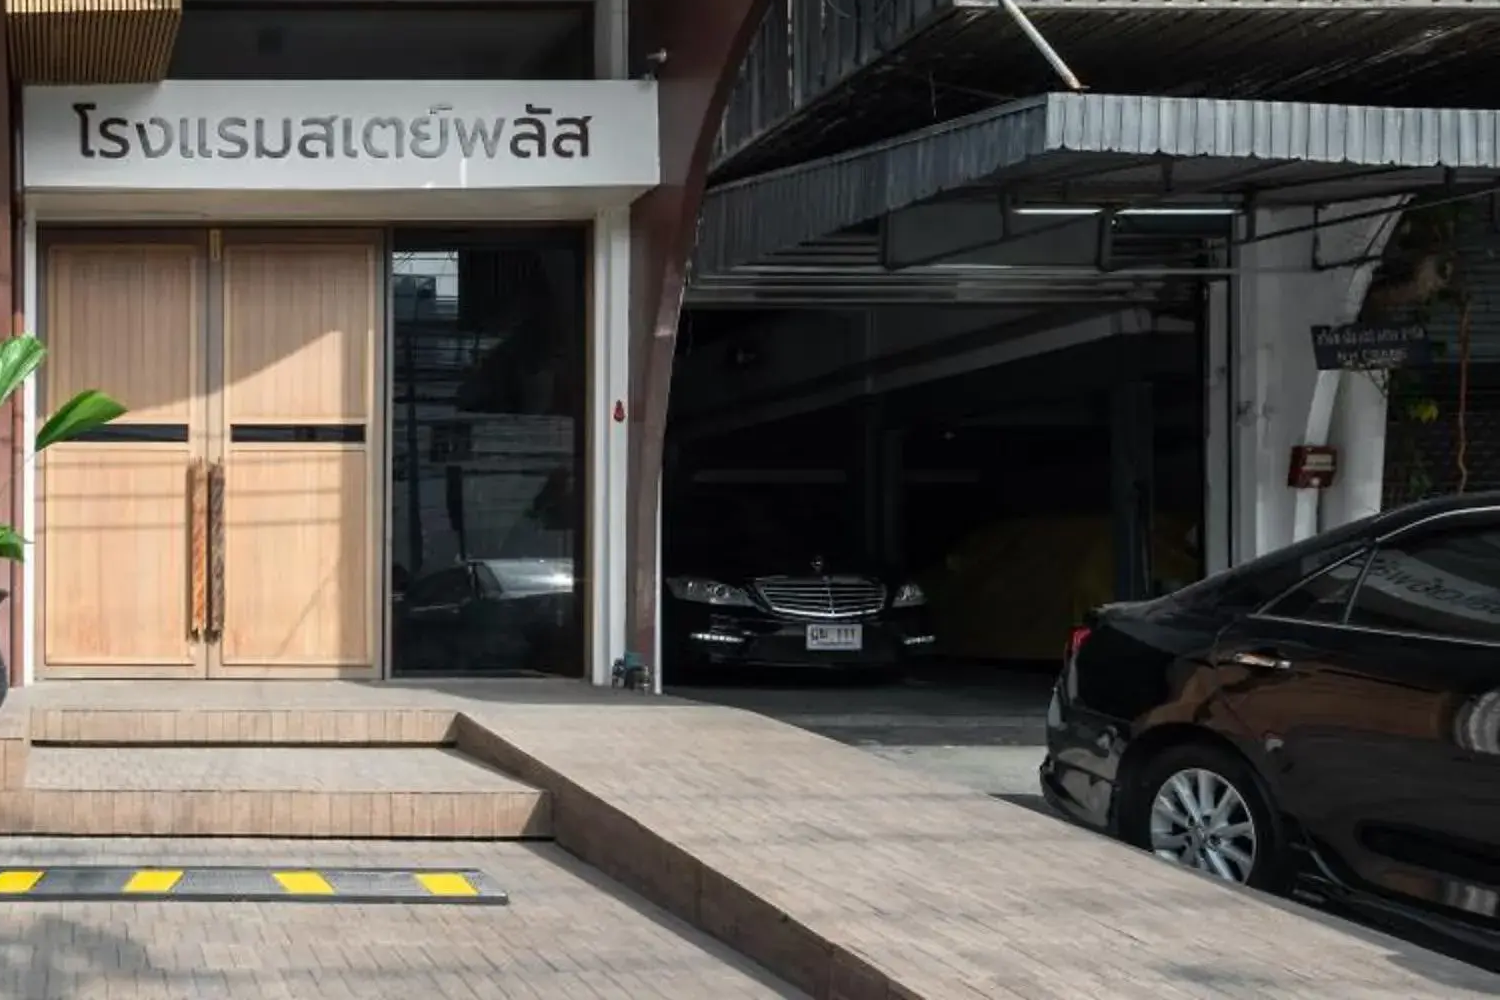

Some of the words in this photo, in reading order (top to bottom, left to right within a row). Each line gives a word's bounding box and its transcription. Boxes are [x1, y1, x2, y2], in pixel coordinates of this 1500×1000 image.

[72, 102, 594, 160] โรงแรมสเตย์พลัส
